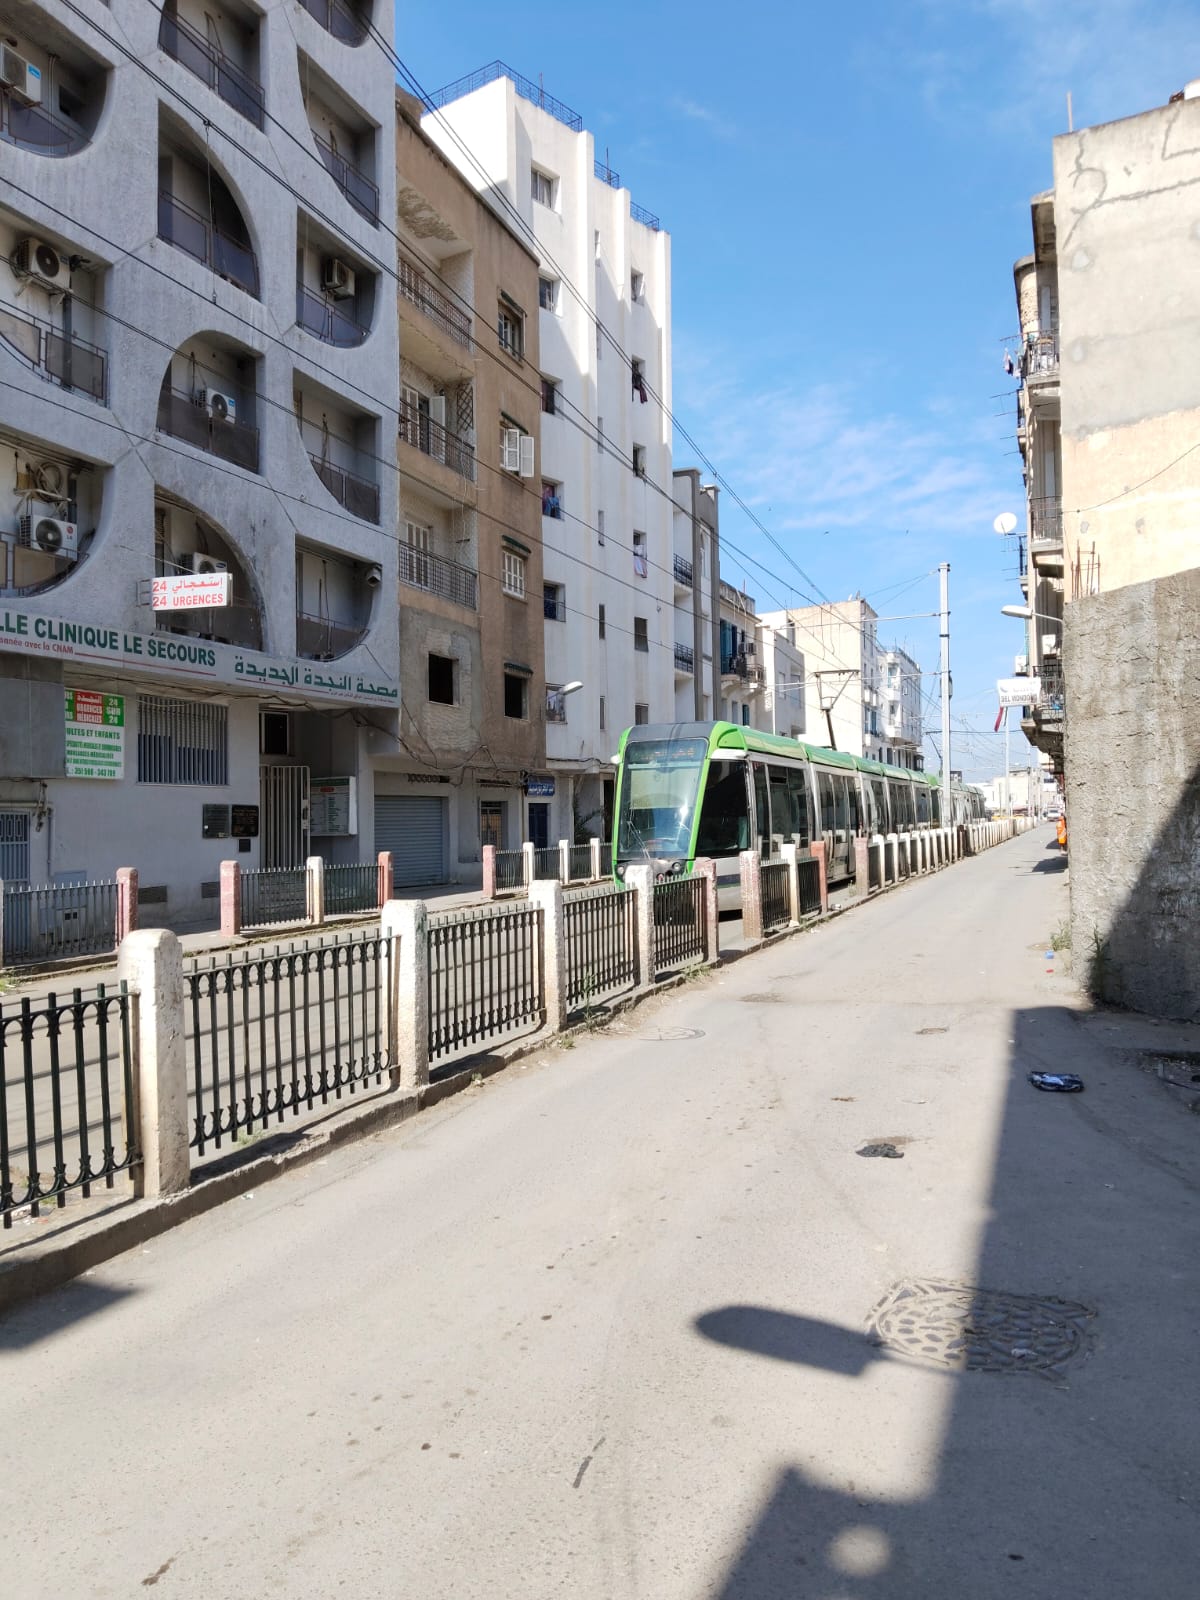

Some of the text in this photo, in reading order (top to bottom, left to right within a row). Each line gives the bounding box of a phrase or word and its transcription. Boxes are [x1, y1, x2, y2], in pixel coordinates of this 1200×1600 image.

[153, 581, 167, 592] 24
[153, 594, 223, 607] 24 URGENCES
[25, 641, 41, 650] avec
[43, 641, 50, 651] la
[52, 643, 74, 654] CNAM
[35, 618, 119, 650] CLINIQUE
[124, 634, 142, 654] LE
[148, 638, 216, 667] SECOURS
[234, 655, 299, 685] الجديدة
[304, 667, 352, 692] النجدة
[357, 677, 398, 698] مصحة
[95, 730, 120, 740] ENFANTS
